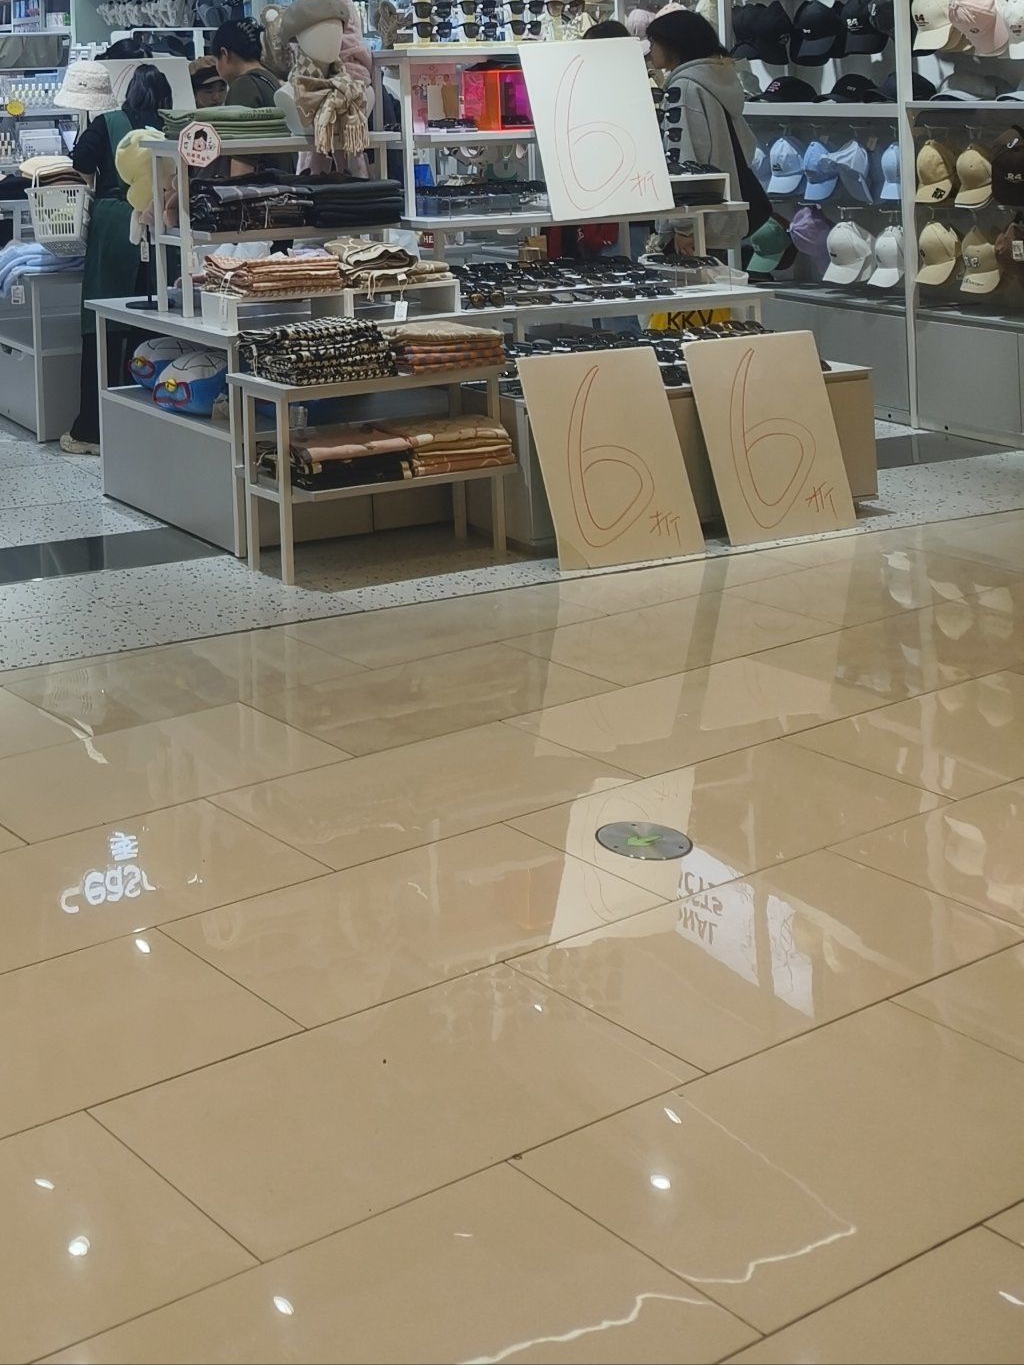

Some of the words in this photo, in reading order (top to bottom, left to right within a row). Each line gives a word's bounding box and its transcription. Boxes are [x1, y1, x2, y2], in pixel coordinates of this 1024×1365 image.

[667, 309, 714, 331] KKV
[567, 364, 681, 548] 6折
[730, 347, 837, 529] 6折
